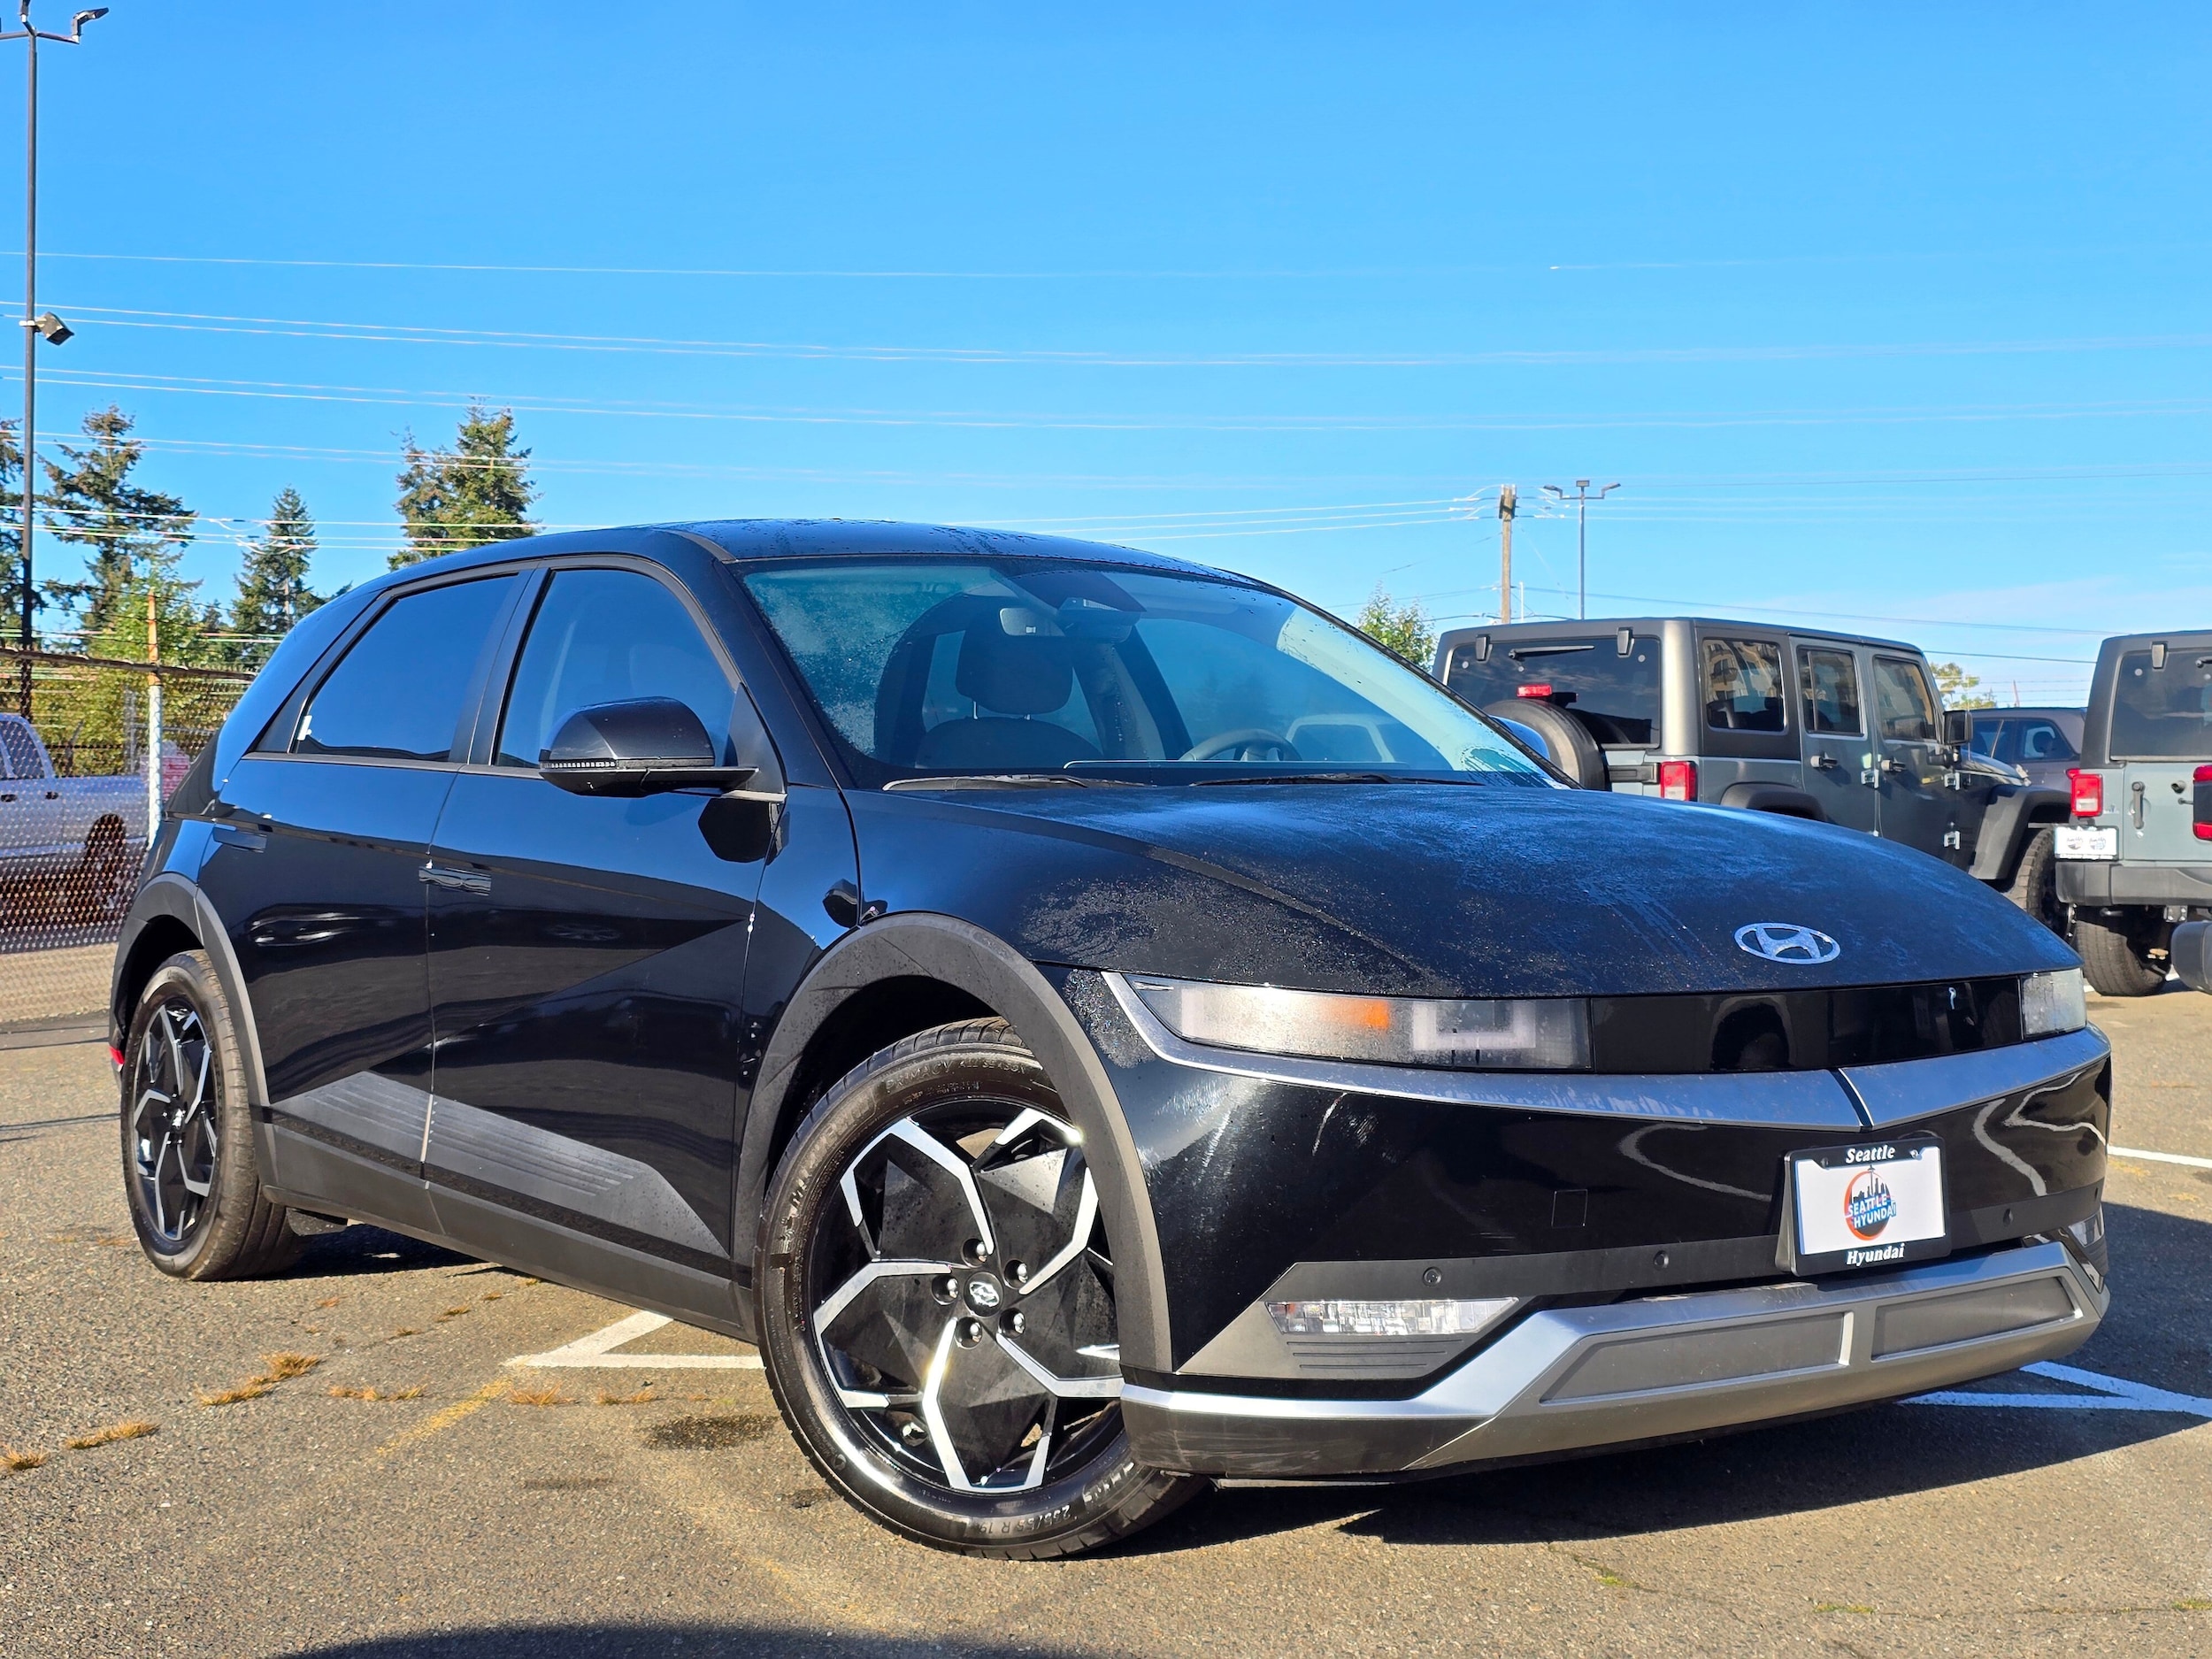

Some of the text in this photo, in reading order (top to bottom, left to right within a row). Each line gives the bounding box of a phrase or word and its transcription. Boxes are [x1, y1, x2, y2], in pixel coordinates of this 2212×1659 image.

[885, 1060, 954, 1093] PRIMACY
[958, 1059, 979, 1069] ALL
[1846, 1145, 1896, 1164] Seattle
[1847, 1194, 1887, 1217] SEATTLE
[1854, 1200, 1897, 1228] HYUNDAI
[1846, 1243, 1905, 1266] Hyundai
[979, 1504, 1071, 1534] 235/55 R 19
